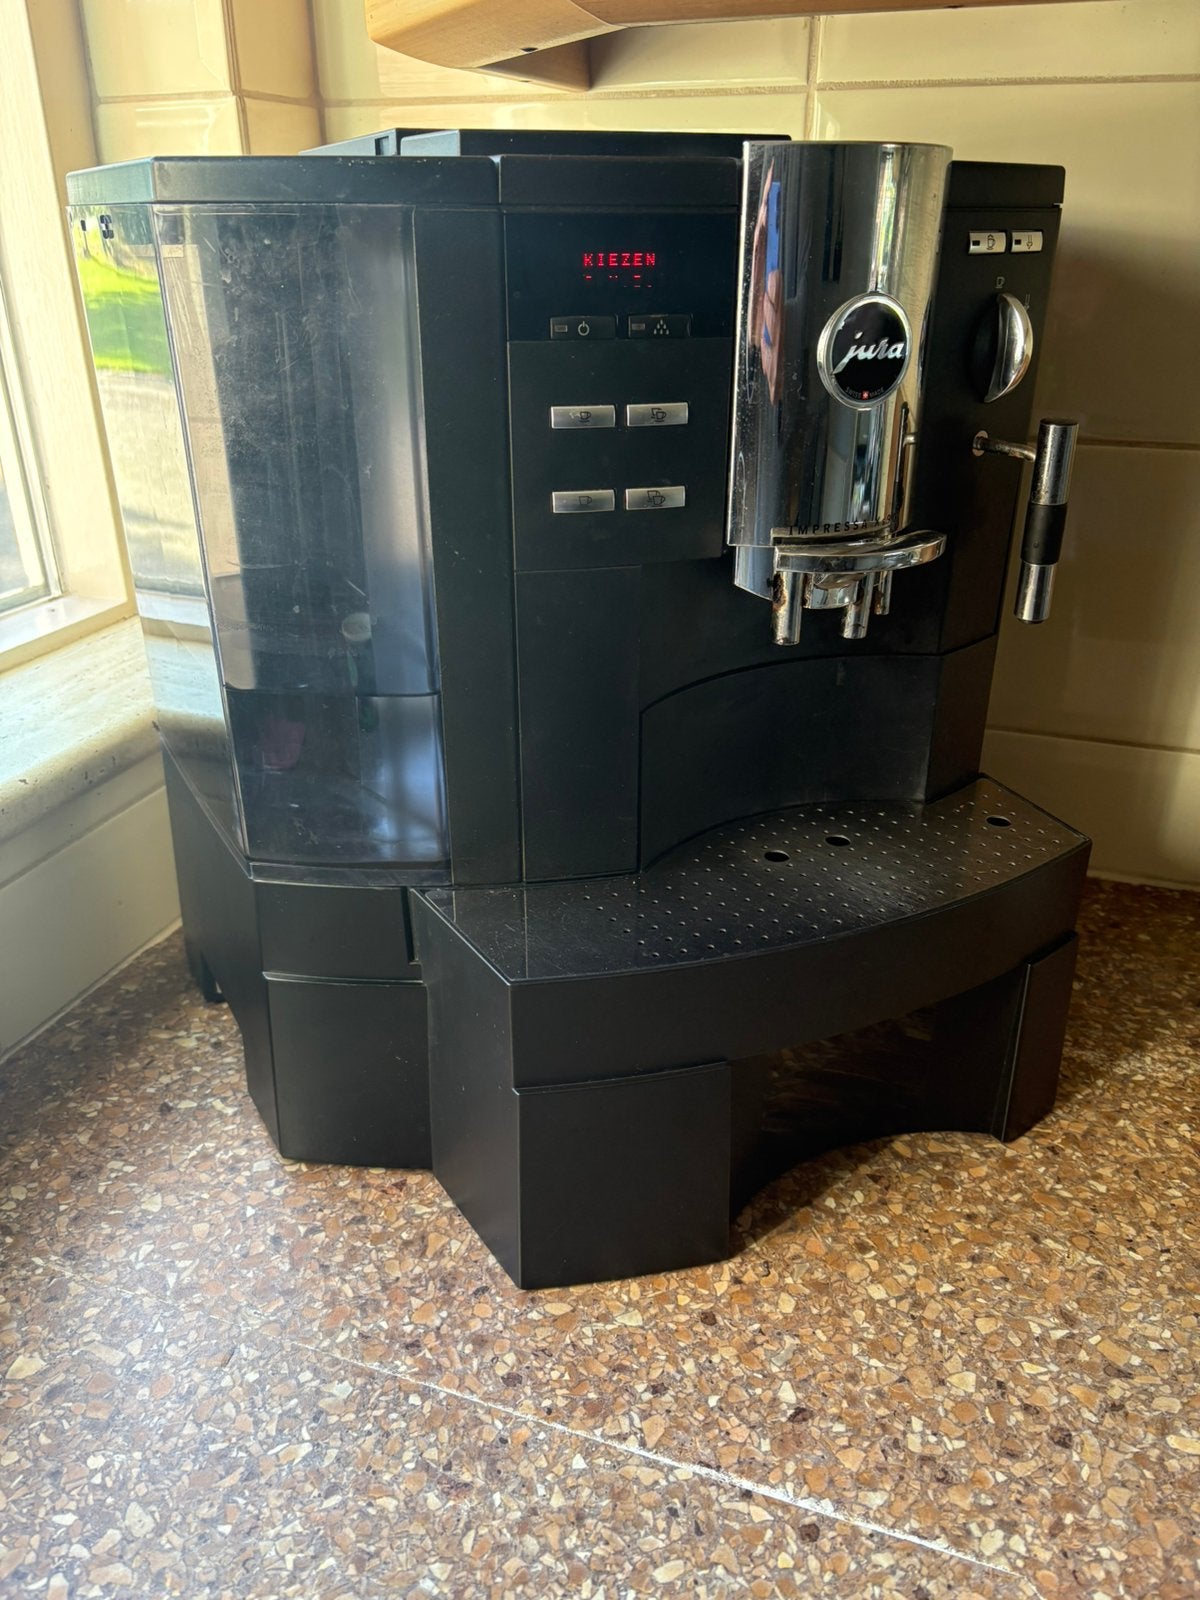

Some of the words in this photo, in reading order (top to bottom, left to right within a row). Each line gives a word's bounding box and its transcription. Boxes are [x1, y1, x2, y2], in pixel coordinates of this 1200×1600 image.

[583, 252, 656, 267] KIEZEN
[832, 331, 905, 374] jura
[788, 519, 868, 536] IMPRESSA
